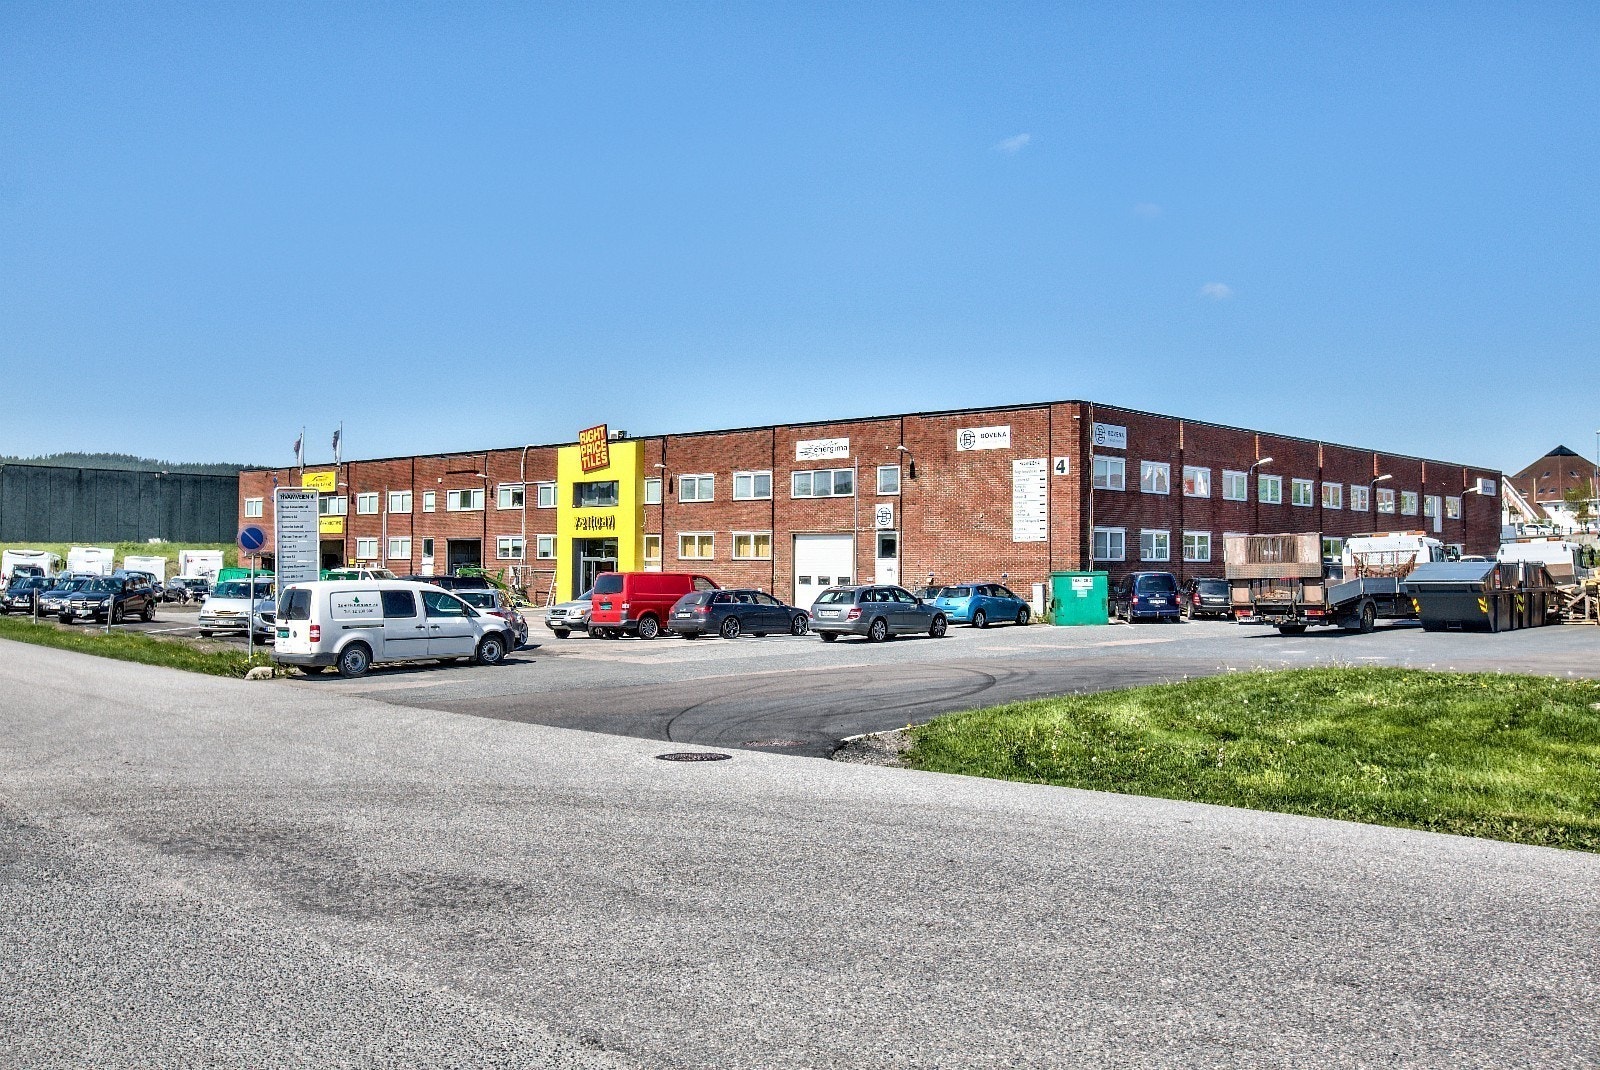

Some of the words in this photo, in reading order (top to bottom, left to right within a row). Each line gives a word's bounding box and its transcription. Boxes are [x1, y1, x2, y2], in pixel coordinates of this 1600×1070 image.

[580, 426, 605, 445] RIGHT
[581, 439, 607, 458] PRICE
[582, 452, 608, 469] TILES
[1055, 459, 1066, 474] 4
